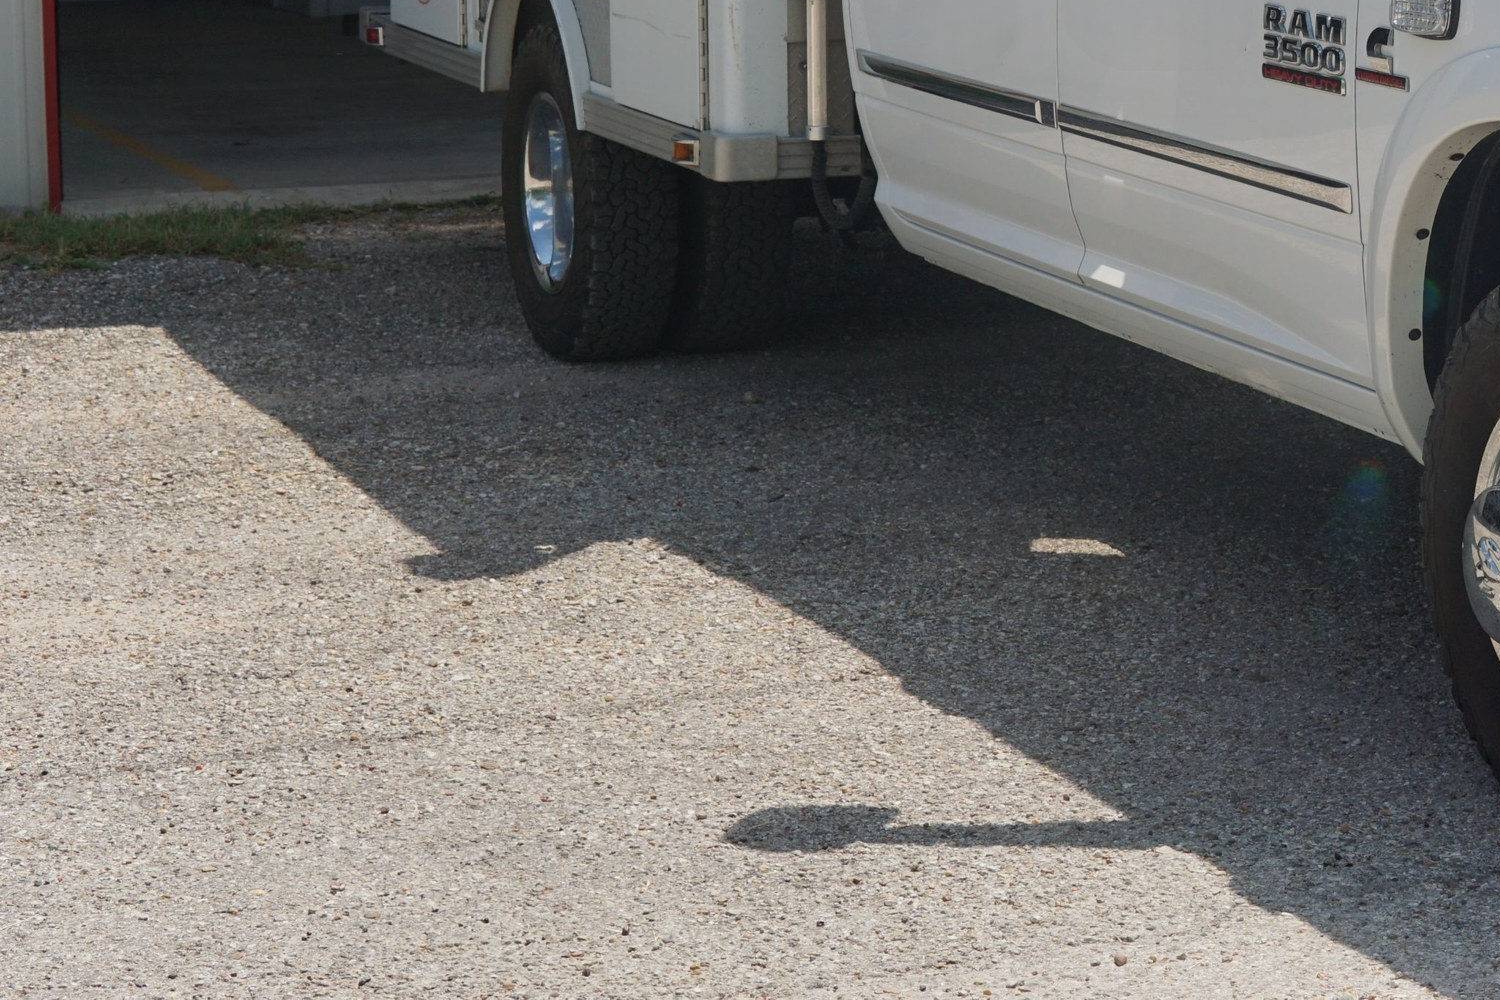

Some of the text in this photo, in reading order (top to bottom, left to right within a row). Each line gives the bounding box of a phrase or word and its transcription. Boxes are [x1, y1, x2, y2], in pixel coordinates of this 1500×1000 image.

[1263, 3, 1347, 46] RAM
[1263, 33, 1346, 77] 3500
[1264, 66, 1339, 93] HEAVY DUTY
